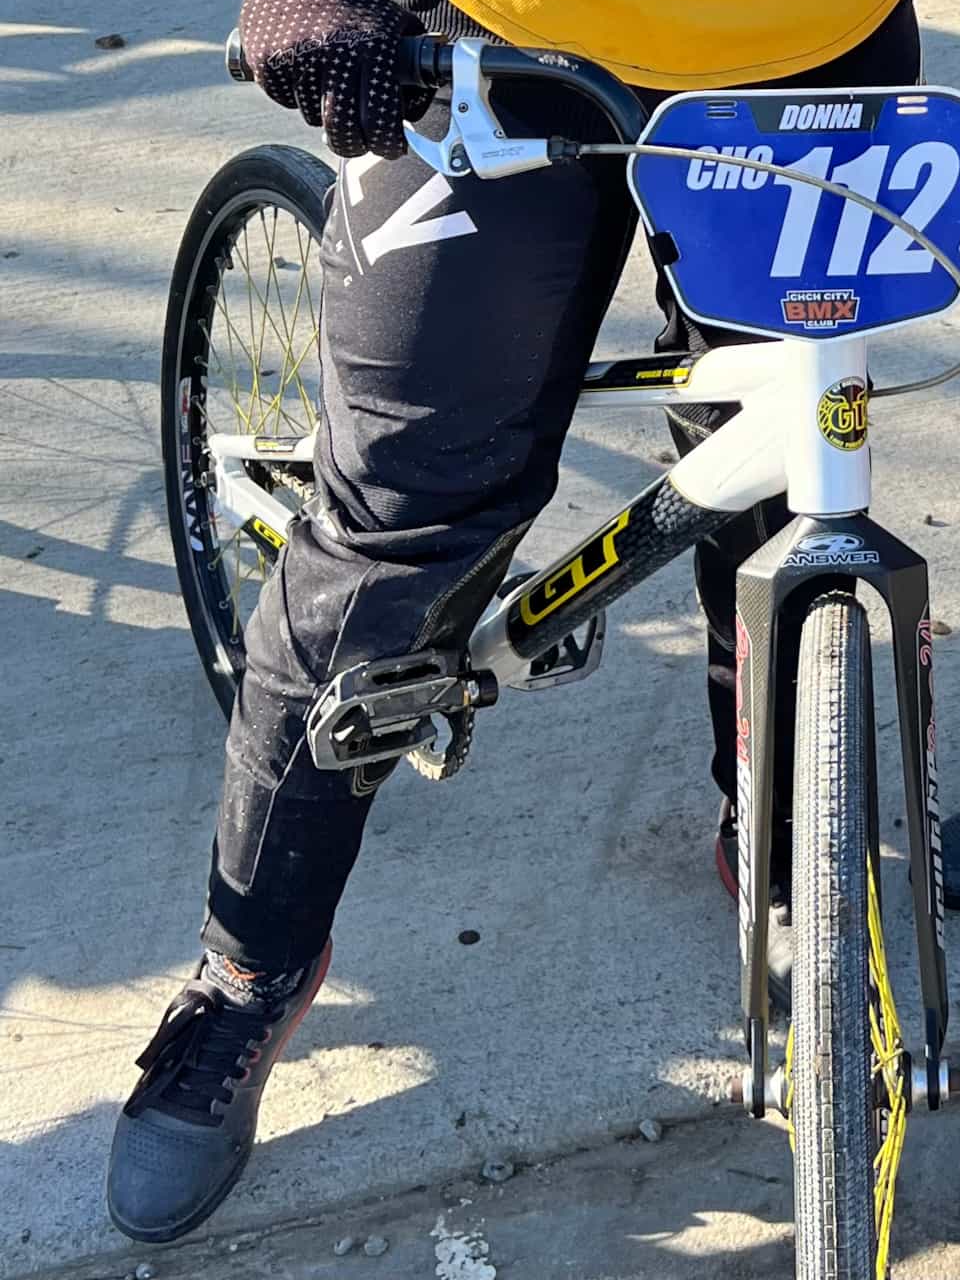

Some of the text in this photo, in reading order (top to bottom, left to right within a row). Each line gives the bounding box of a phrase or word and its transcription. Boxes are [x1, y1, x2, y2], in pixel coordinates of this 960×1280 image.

[779, 104, 863, 130] DONNA
[686, 141, 960, 278] CHC 112
[790, 292, 849, 302] CHCH CITY
[785, 301, 855, 320] BMX
[807, 319, 834, 327] CLUB
[519, 507, 632, 626] GT
[781, 551, 880, 568] ANSWER
